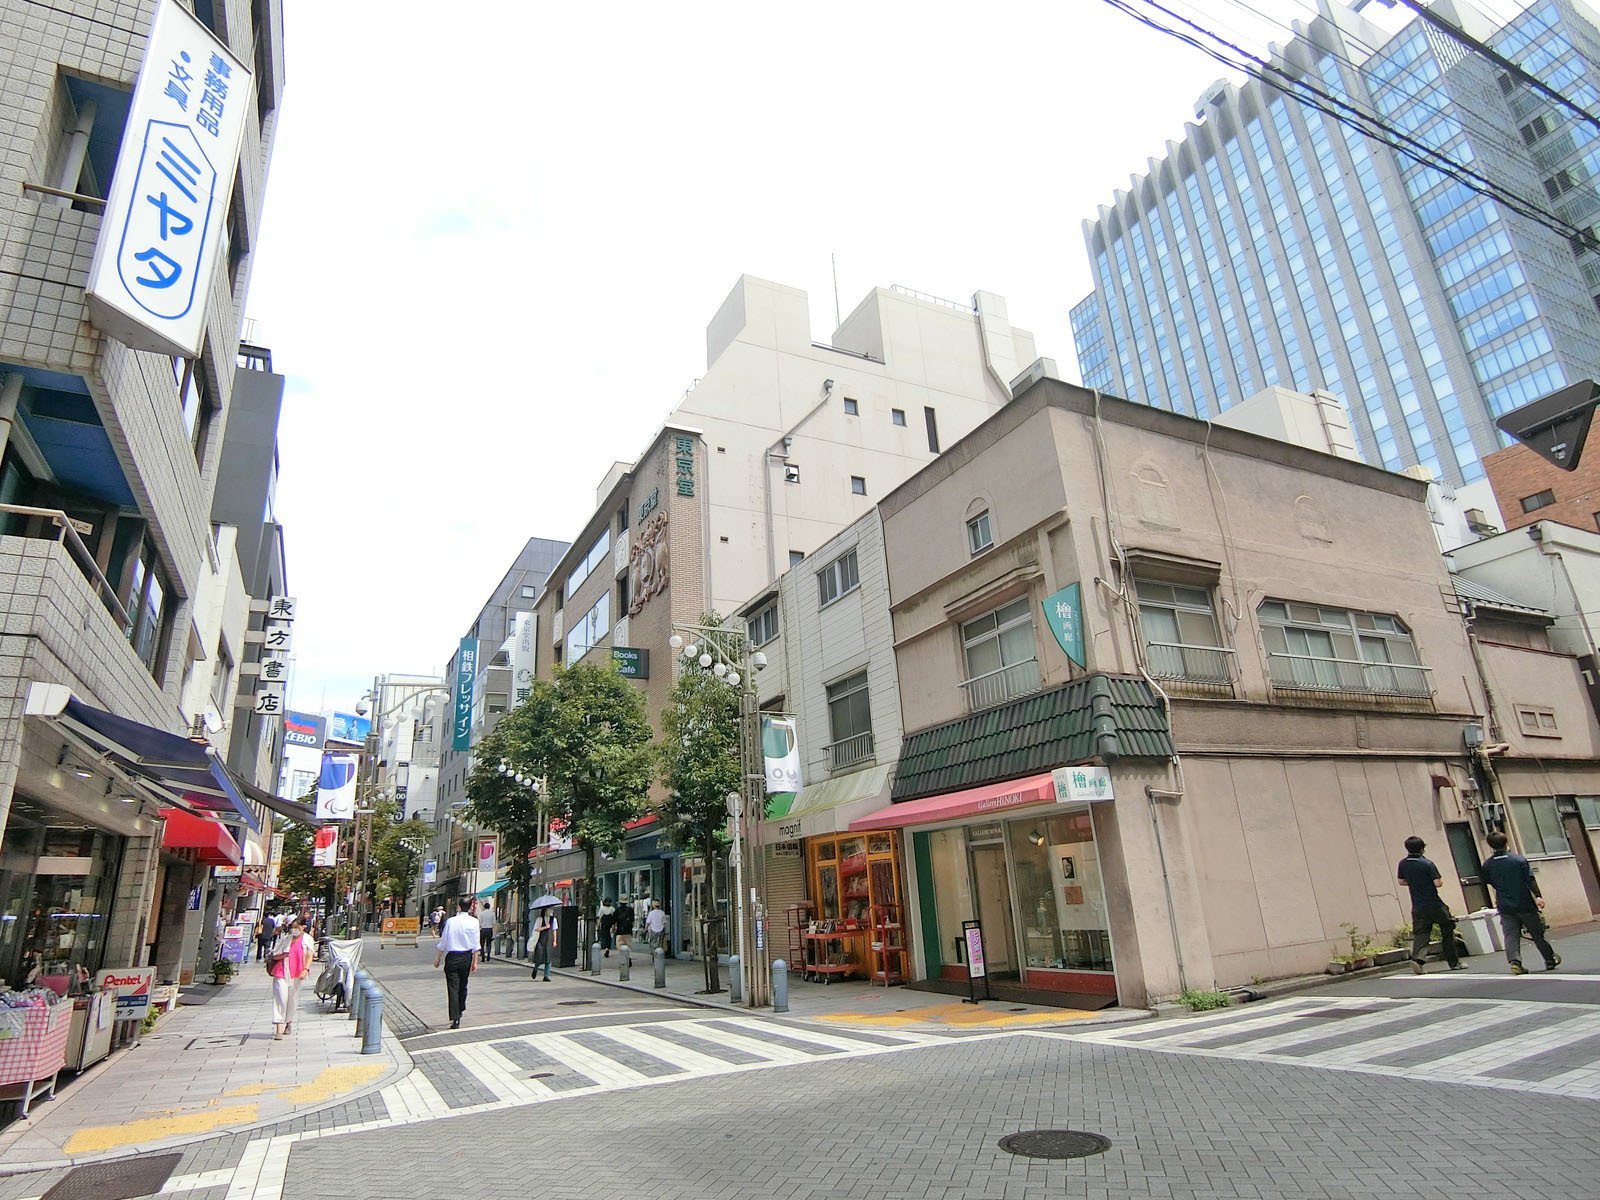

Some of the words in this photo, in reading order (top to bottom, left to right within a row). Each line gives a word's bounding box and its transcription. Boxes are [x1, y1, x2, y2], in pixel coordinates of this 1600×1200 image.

[195, 50, 233, 137] 事務用品
[134, 136, 202, 289] ミヤタ
[676, 436, 695, 497] 東京堂
[638, 487, 658, 525] 東京堂
[256, 598, 293, 713] 東方書店
[613, 650, 638, 660] Books
[616, 666, 636, 674] Café
[458, 650, 474, 738] 相鉄フレッサイン
[996, 791, 1023, 807] HINOKI
[104, 974, 142, 986] Pentel
